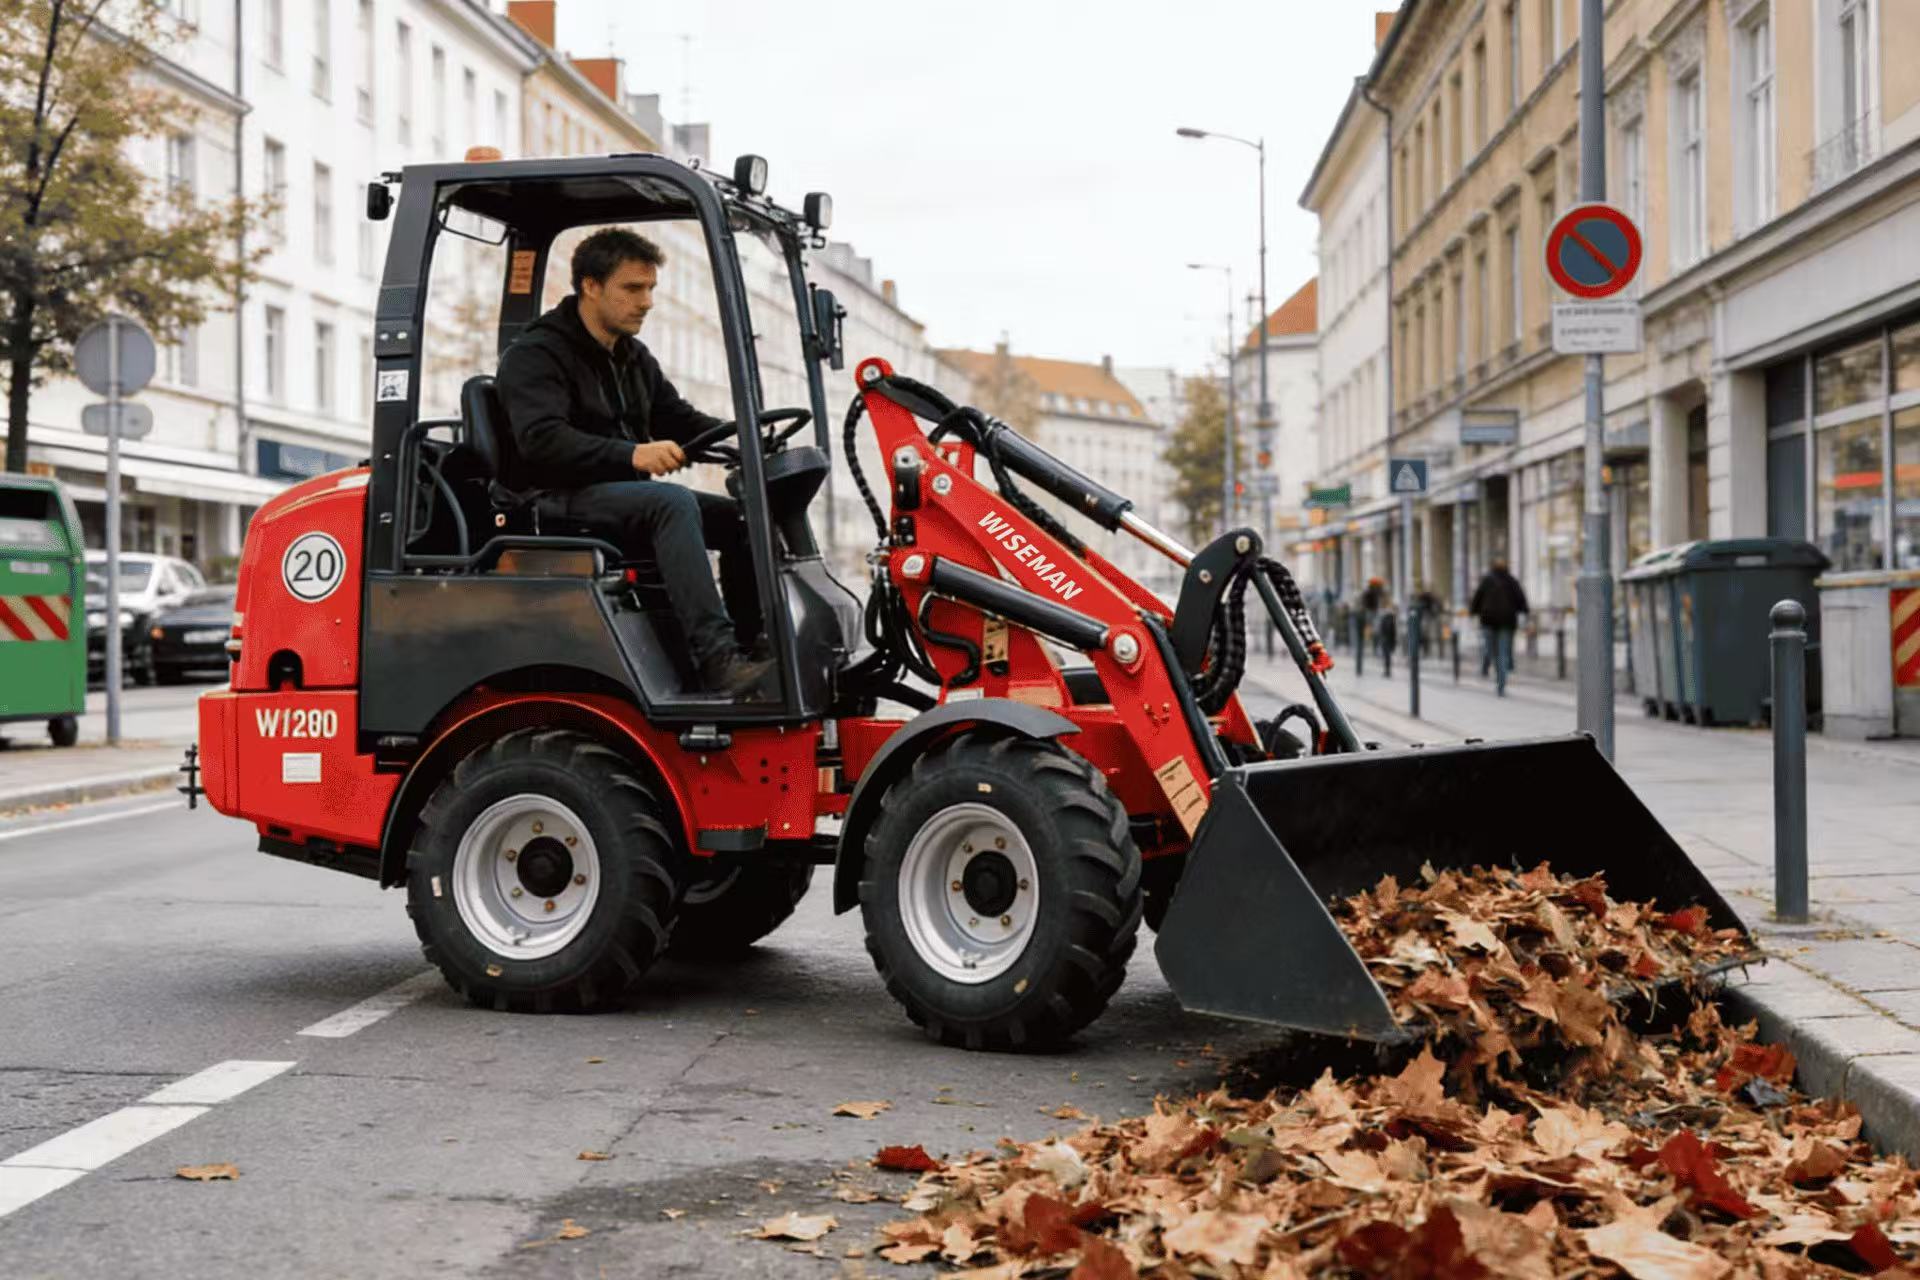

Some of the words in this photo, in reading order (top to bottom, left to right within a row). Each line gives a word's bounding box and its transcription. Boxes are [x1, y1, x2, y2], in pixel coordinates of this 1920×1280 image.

[293, 549, 336, 582] 20
[978, 510, 1083, 601] WISEMAN
[255, 707, 338, 739] W1280
